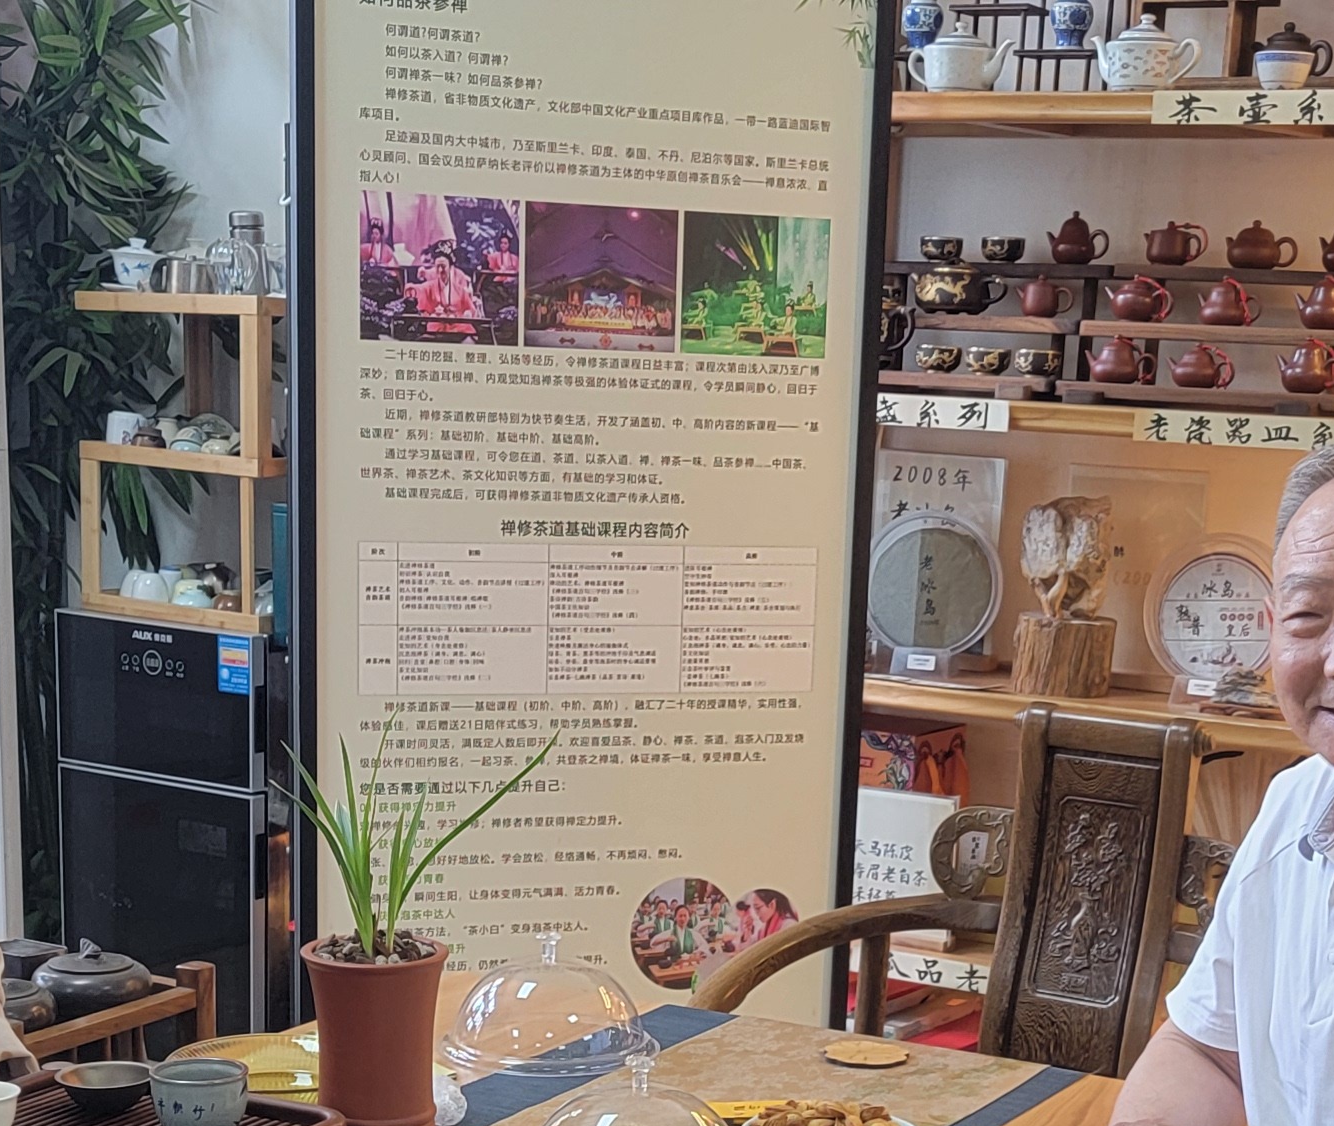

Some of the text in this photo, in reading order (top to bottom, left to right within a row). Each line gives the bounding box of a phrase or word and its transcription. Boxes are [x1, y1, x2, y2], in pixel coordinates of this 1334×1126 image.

[358, 107, 401, 123] 库项目。
[359, 170, 401, 184] 指人心！
[359, 387, 435, 402] 茶、回归于心。
[893, 465, 973, 491] 2008年
[500, 519, 690, 539] 禅修茶道基础课程内容简介
[131, 629, 153, 641] AUX
